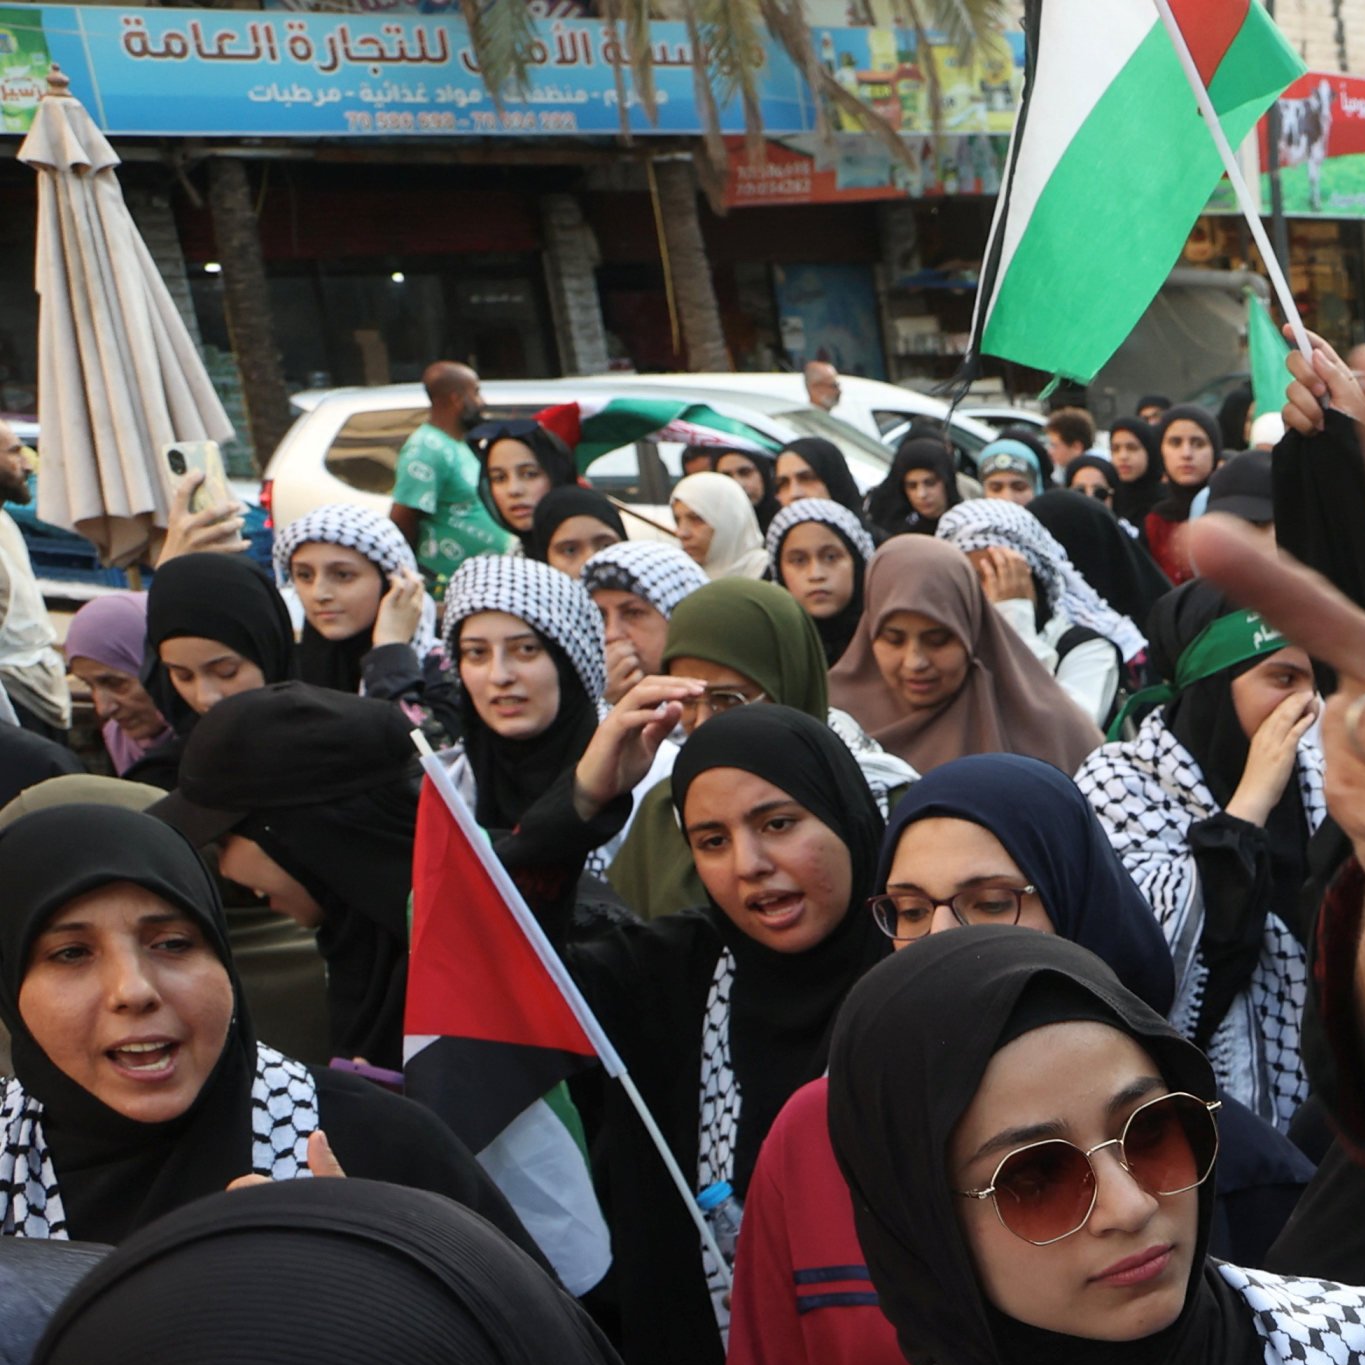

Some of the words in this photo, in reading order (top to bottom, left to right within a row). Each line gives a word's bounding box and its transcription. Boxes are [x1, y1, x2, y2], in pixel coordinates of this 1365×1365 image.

[122, 16, 279, 62] العامة
[287, 20, 451, 76] للتجارة
[248, 82, 342, 107] مرطبات
[360, 80, 430, 109] غذائية
[503, 82, 588, 104] منظف
